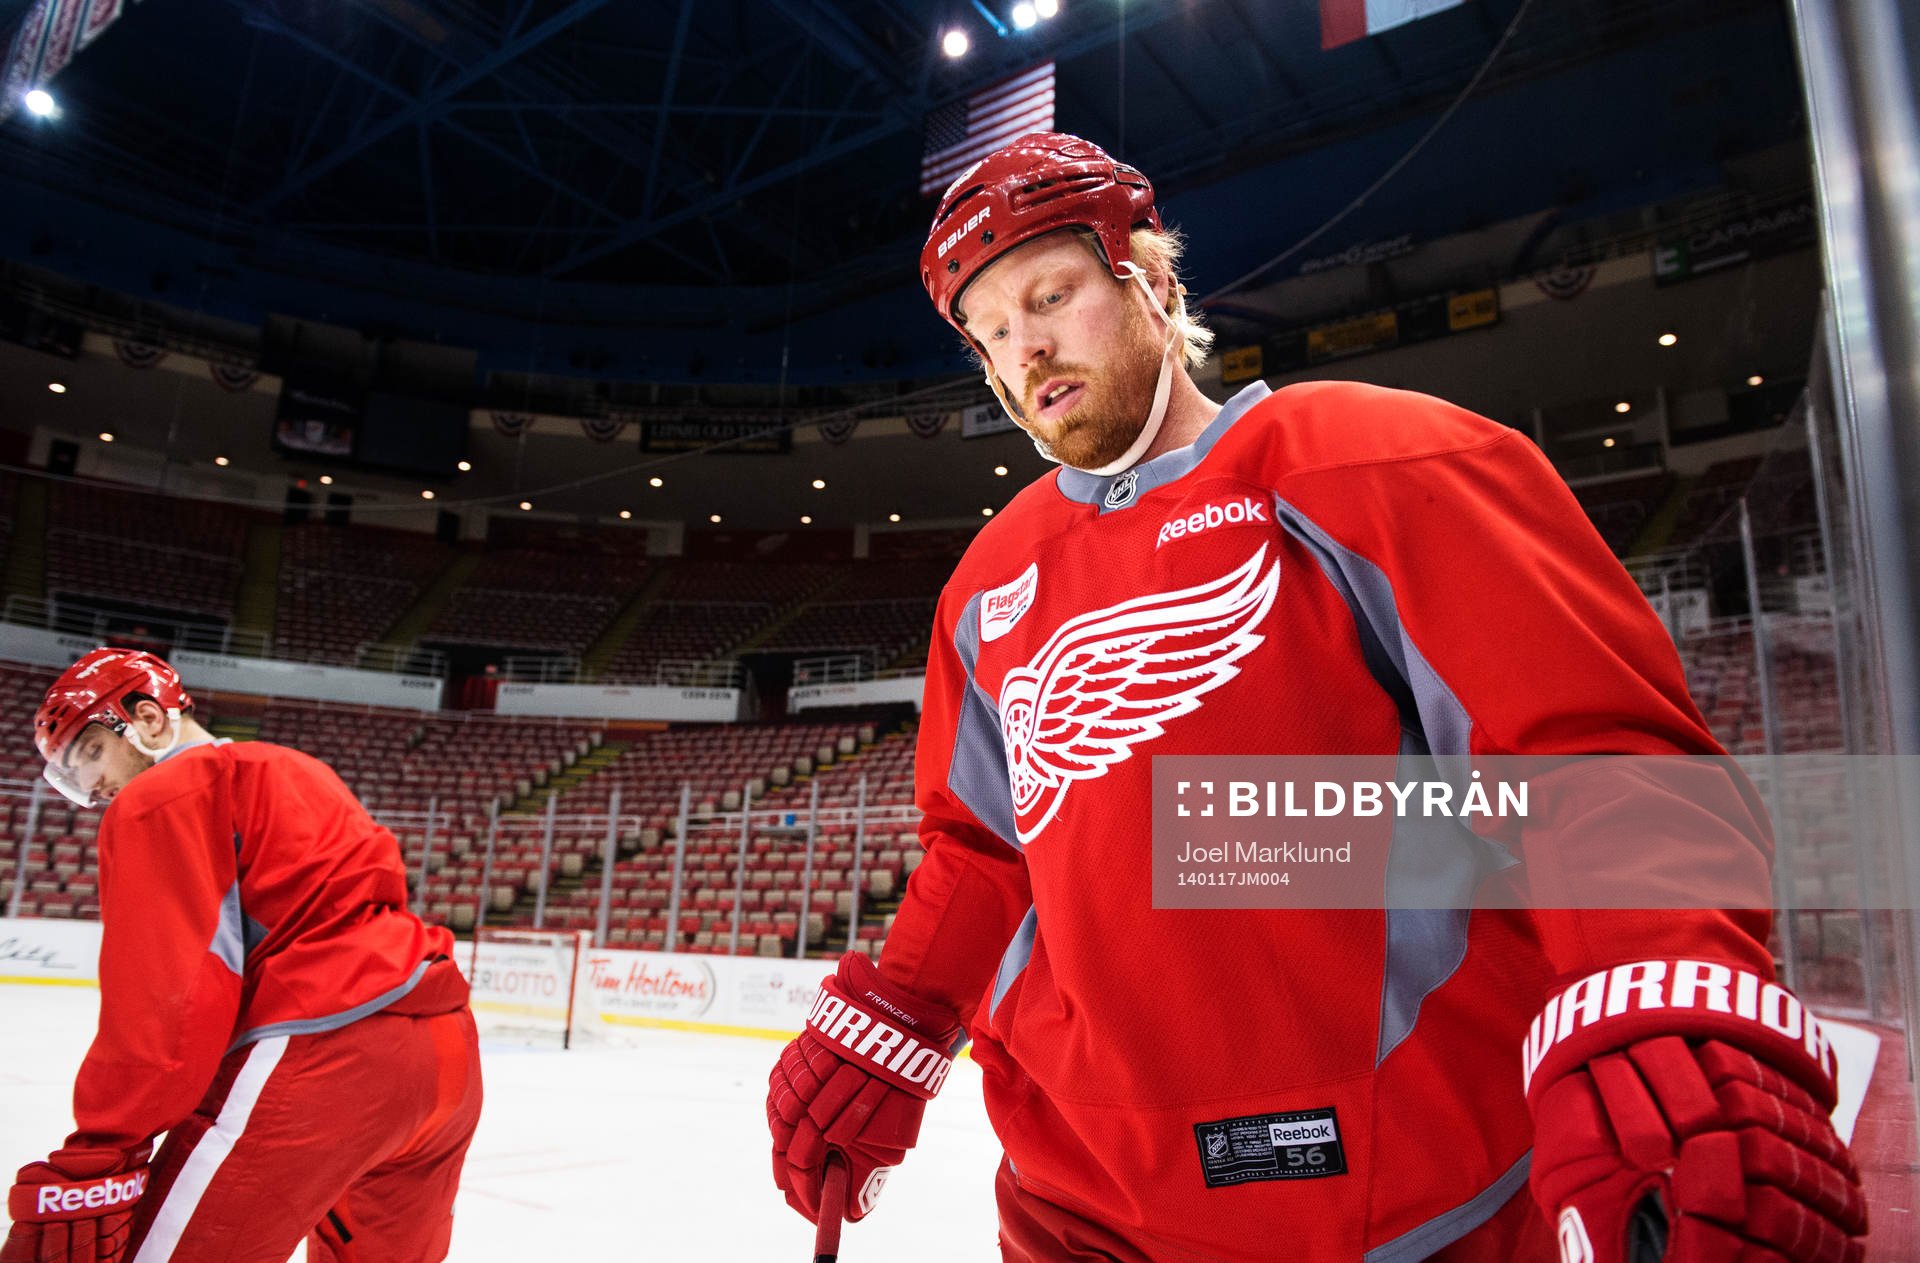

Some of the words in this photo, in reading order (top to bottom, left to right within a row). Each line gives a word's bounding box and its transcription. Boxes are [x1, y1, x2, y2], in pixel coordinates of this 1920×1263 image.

[1156, 498, 1267, 550] Reebok
[589, 958, 619, 990] Tim
[624, 961, 707, 1000] Hortons
[865, 991, 918, 1026] FRANZEN
[1522, 960, 1831, 1099] WARRIOR
[1273, 1125, 1330, 1141] Reebok
[1286, 1146, 1327, 1167] 56
[37, 1172, 146, 1214] Reebok
